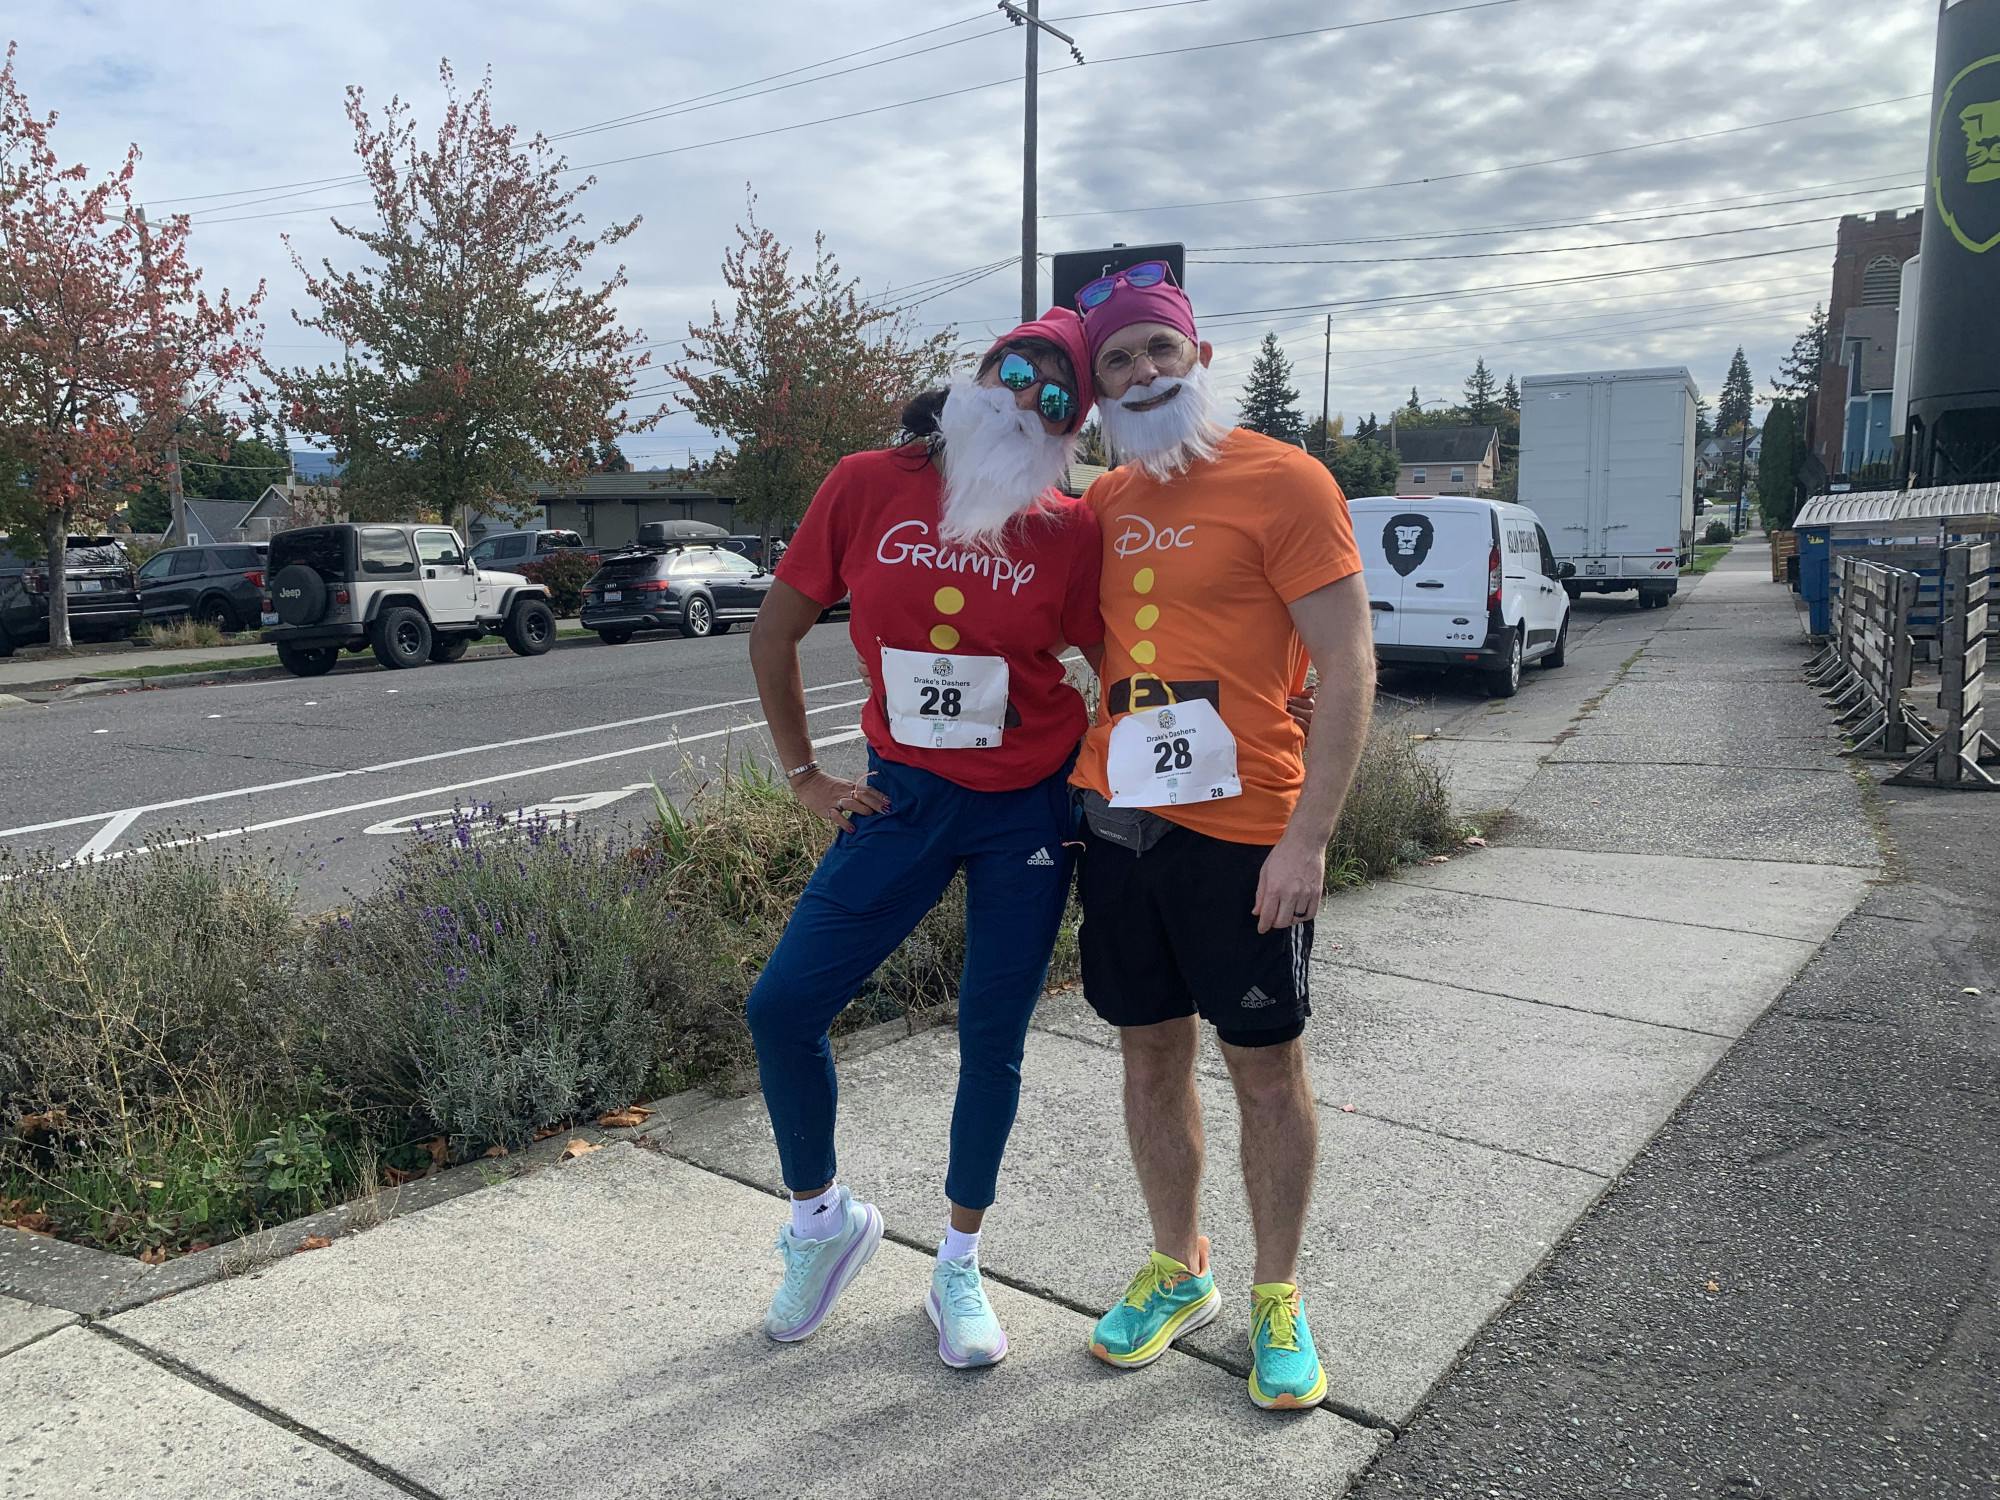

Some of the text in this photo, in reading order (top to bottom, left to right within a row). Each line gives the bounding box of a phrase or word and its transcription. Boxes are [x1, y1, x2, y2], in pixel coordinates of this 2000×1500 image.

[1114, 514, 1196, 560] Doc
[279, 587, 301, 598] Jeep
[913, 676, 971, 687] Drake's Dashers
[920, 686, 961, 717] 28
[1146, 727, 1197, 743] Drake's Dashers
[975, 737, 988, 747] 28
[1153, 737, 1193, 774] 28
[1210, 787, 1224, 798] 28
[1026, 858, 1055, 866] adidas
[1240, 998, 1277, 1009] adidas
